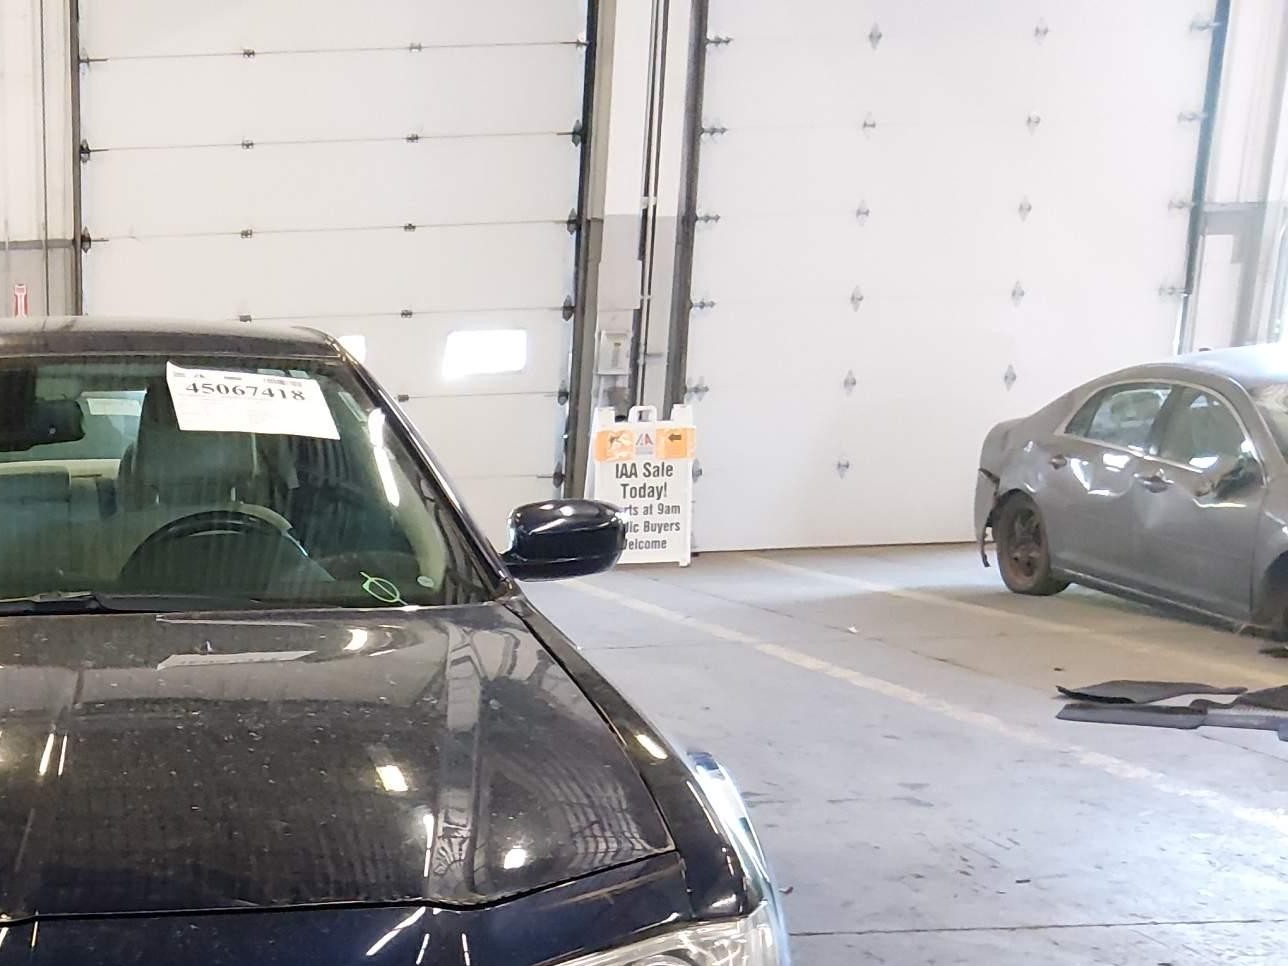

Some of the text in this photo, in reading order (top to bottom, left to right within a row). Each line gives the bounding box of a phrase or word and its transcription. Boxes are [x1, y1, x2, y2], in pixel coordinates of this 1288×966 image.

[185, 382, 306, 401] 45067418
[615, 461, 674, 479] IAA Sale
[621, 482, 668, 500] Today!
[642, 504, 654, 516] at
[657, 503, 681, 515] 9am
[643, 520, 681, 535] Buyers
